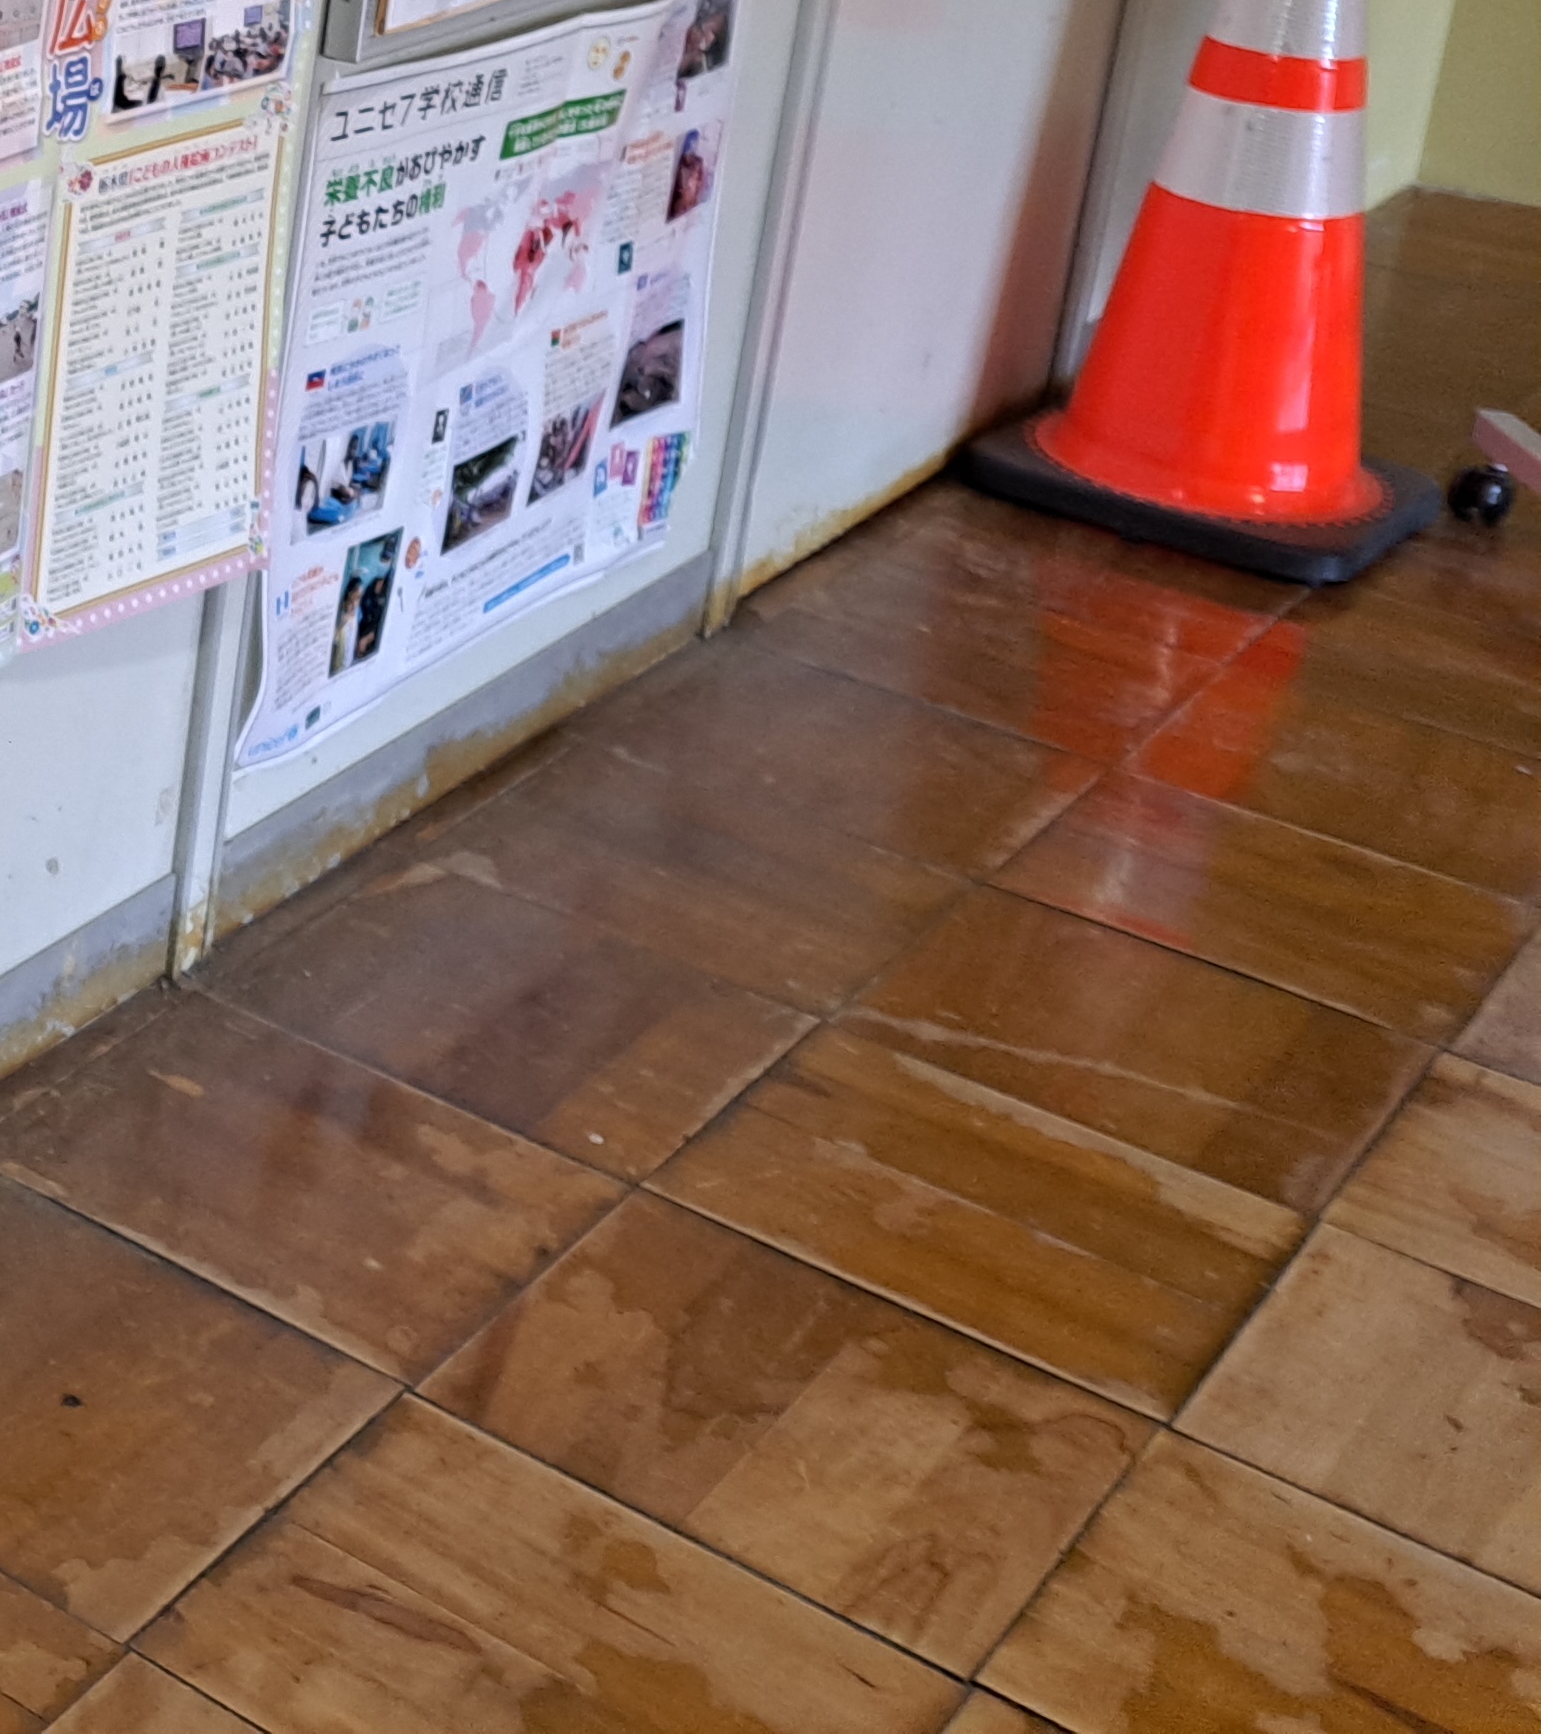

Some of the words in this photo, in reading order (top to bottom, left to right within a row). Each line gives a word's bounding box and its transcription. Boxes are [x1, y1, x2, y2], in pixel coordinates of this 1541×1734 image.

[330, 67, 508, 142] ユニセフ学校通信
